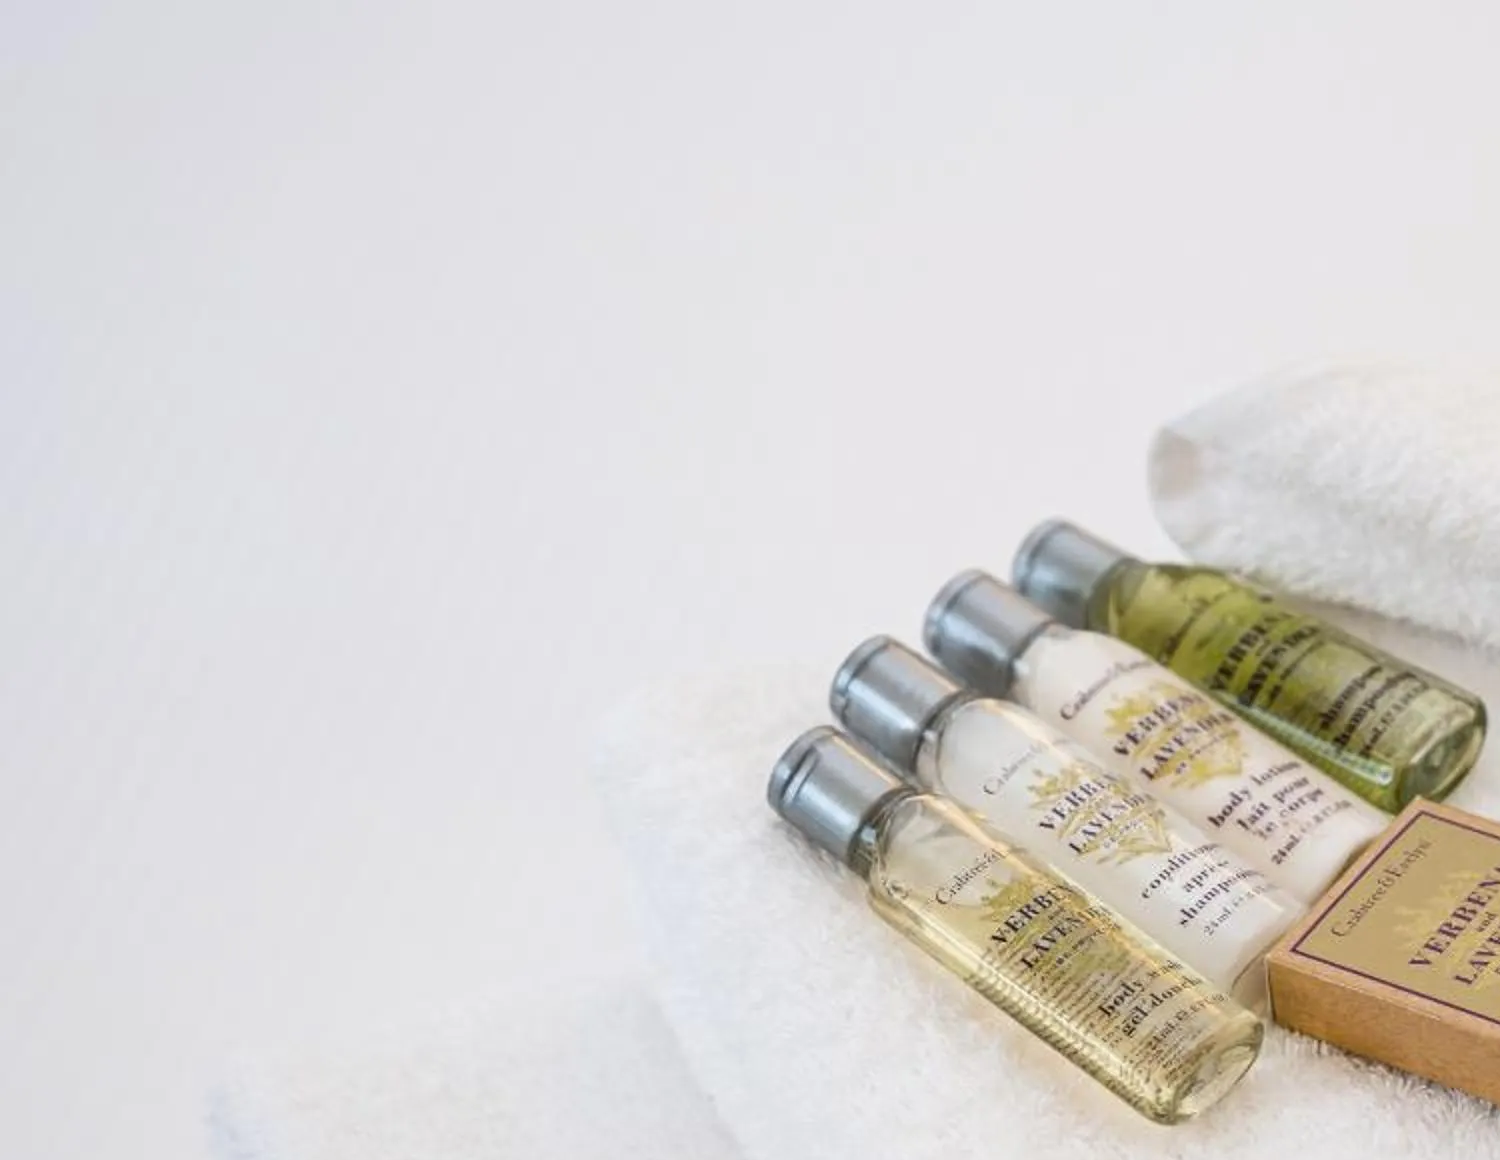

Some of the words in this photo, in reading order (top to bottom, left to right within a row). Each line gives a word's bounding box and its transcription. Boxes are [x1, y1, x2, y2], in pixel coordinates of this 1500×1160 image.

[1207, 788, 1252, 828] body
[1236, 802, 1272, 831] lait
[1272, 777, 1309, 804] pour
[1476, 911, 1498, 934] and
[1097, 979, 1145, 1017] body
[1122, 1005, 1149, 1039] gel
